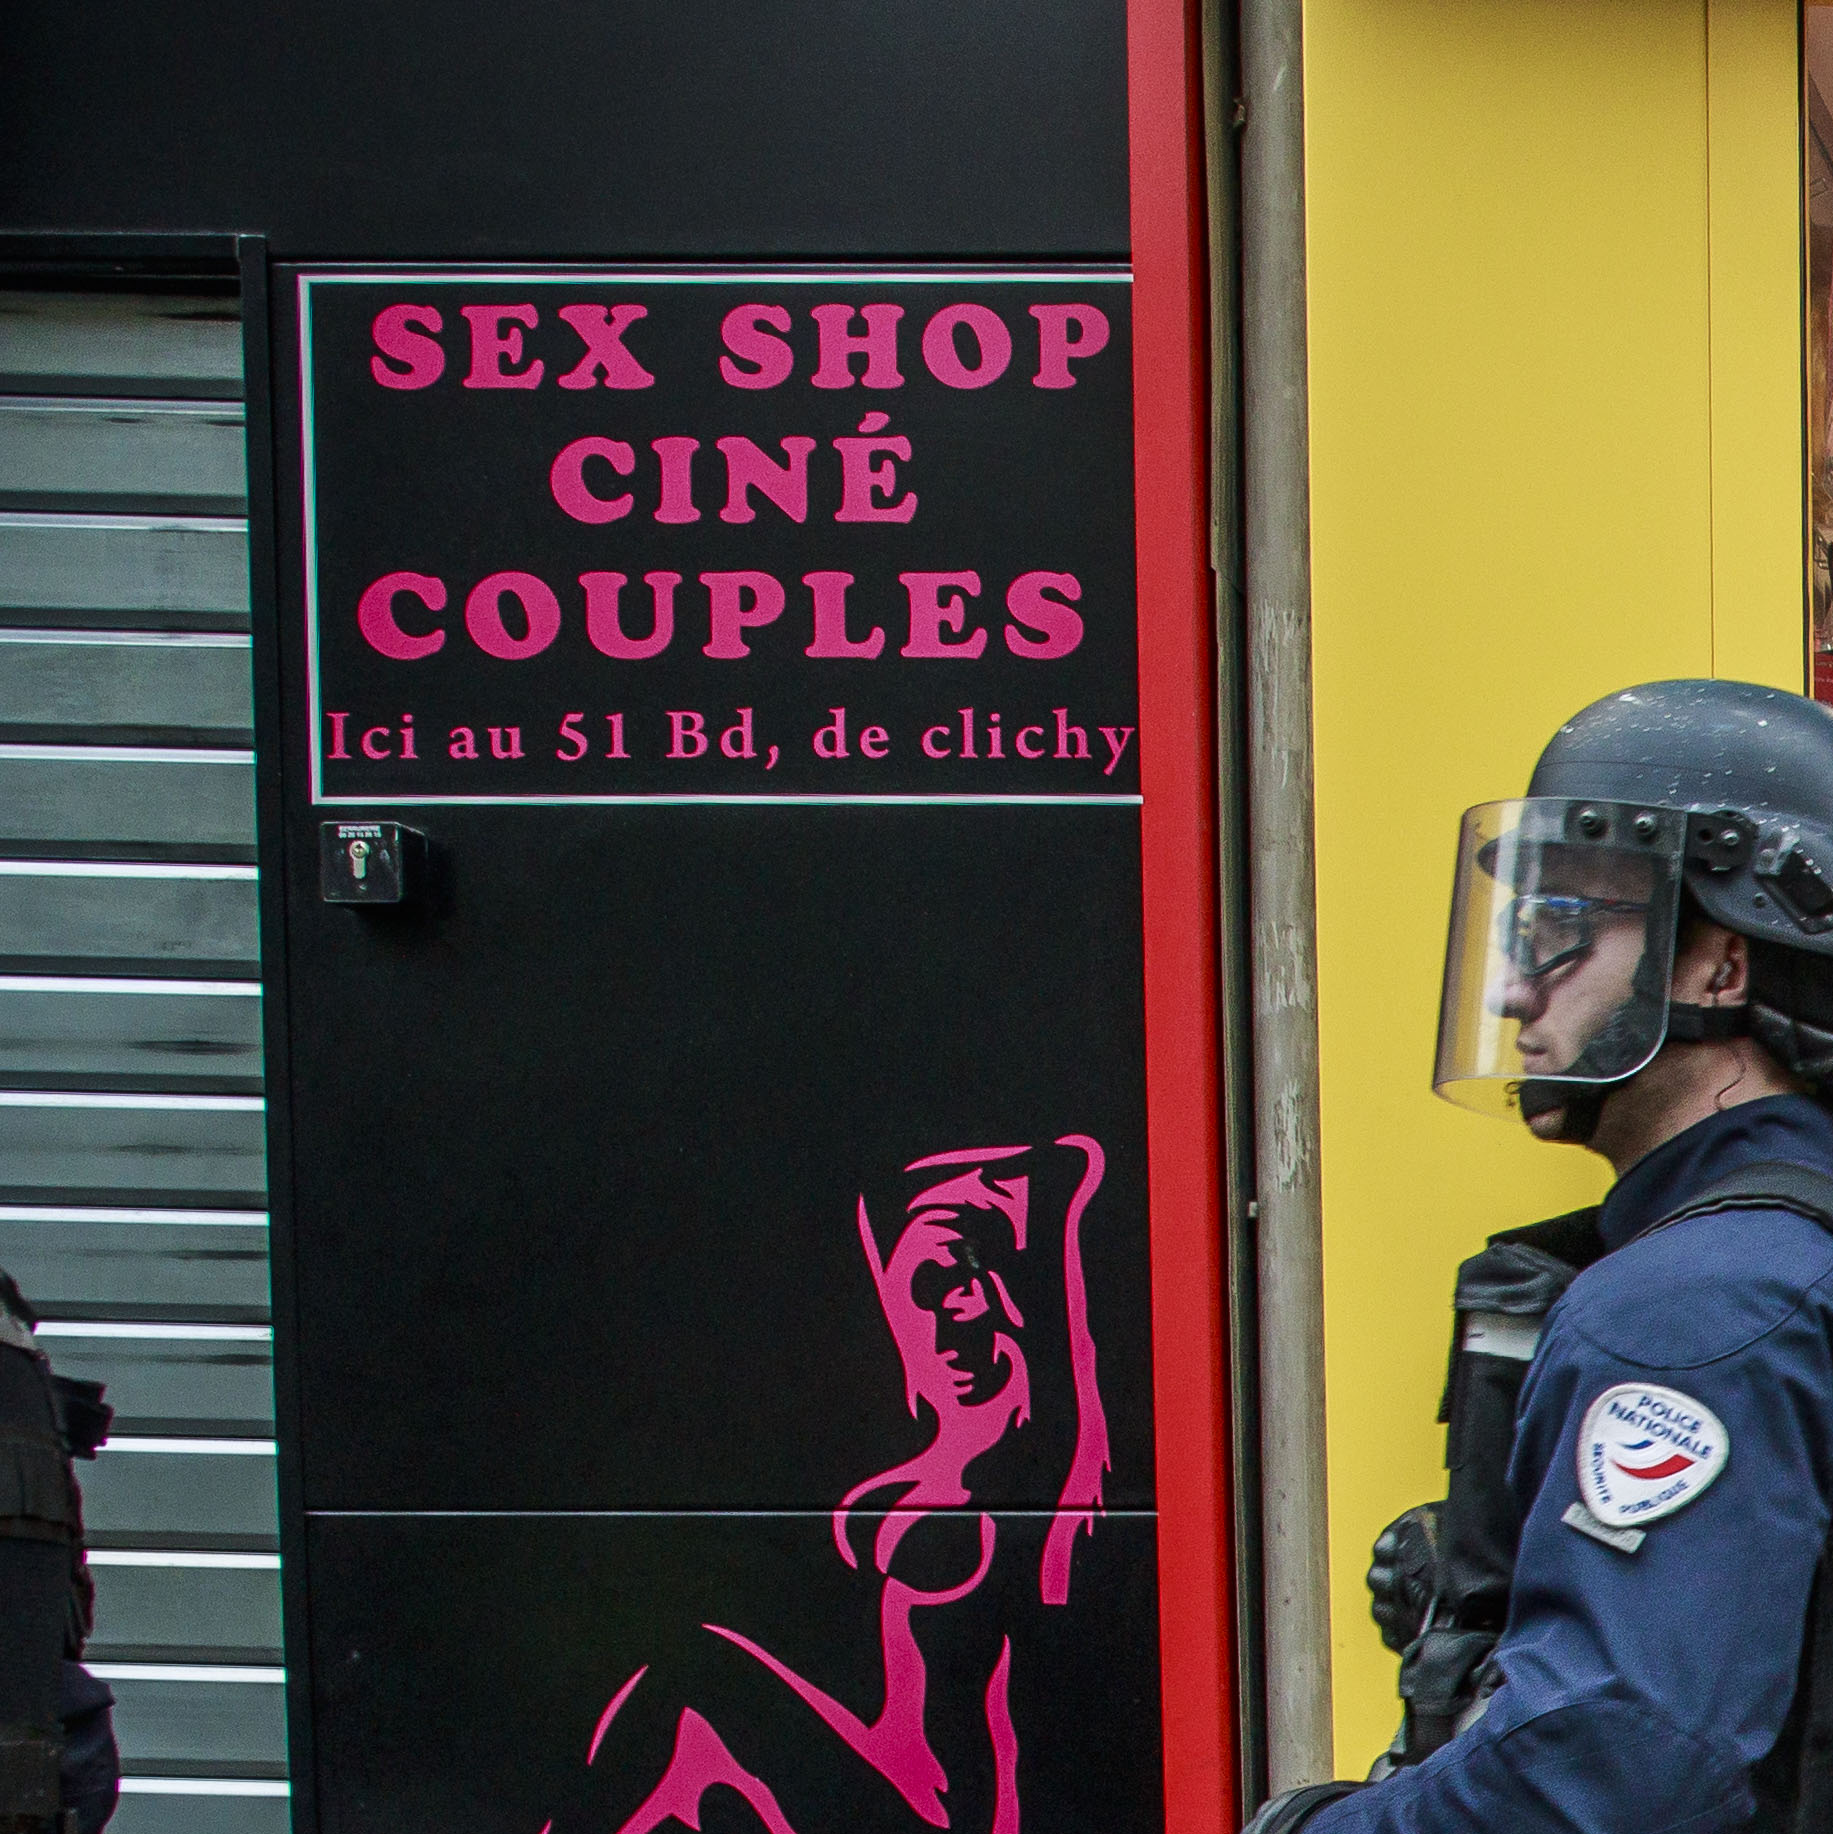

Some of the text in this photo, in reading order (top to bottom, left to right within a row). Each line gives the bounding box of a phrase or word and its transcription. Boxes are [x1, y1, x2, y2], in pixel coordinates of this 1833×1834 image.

[370, 303, 1111, 391] SEX SHOP
[549, 411, 918, 524] CINÉ
[357, 570, 1085, 660] COUPLES
[327, 707, 1136, 775] Ici au 51 Bd, de clichy
[1608, 1402, 1714, 1460] NATIONALE
[1638, 1395, 1703, 1434] POLICE
